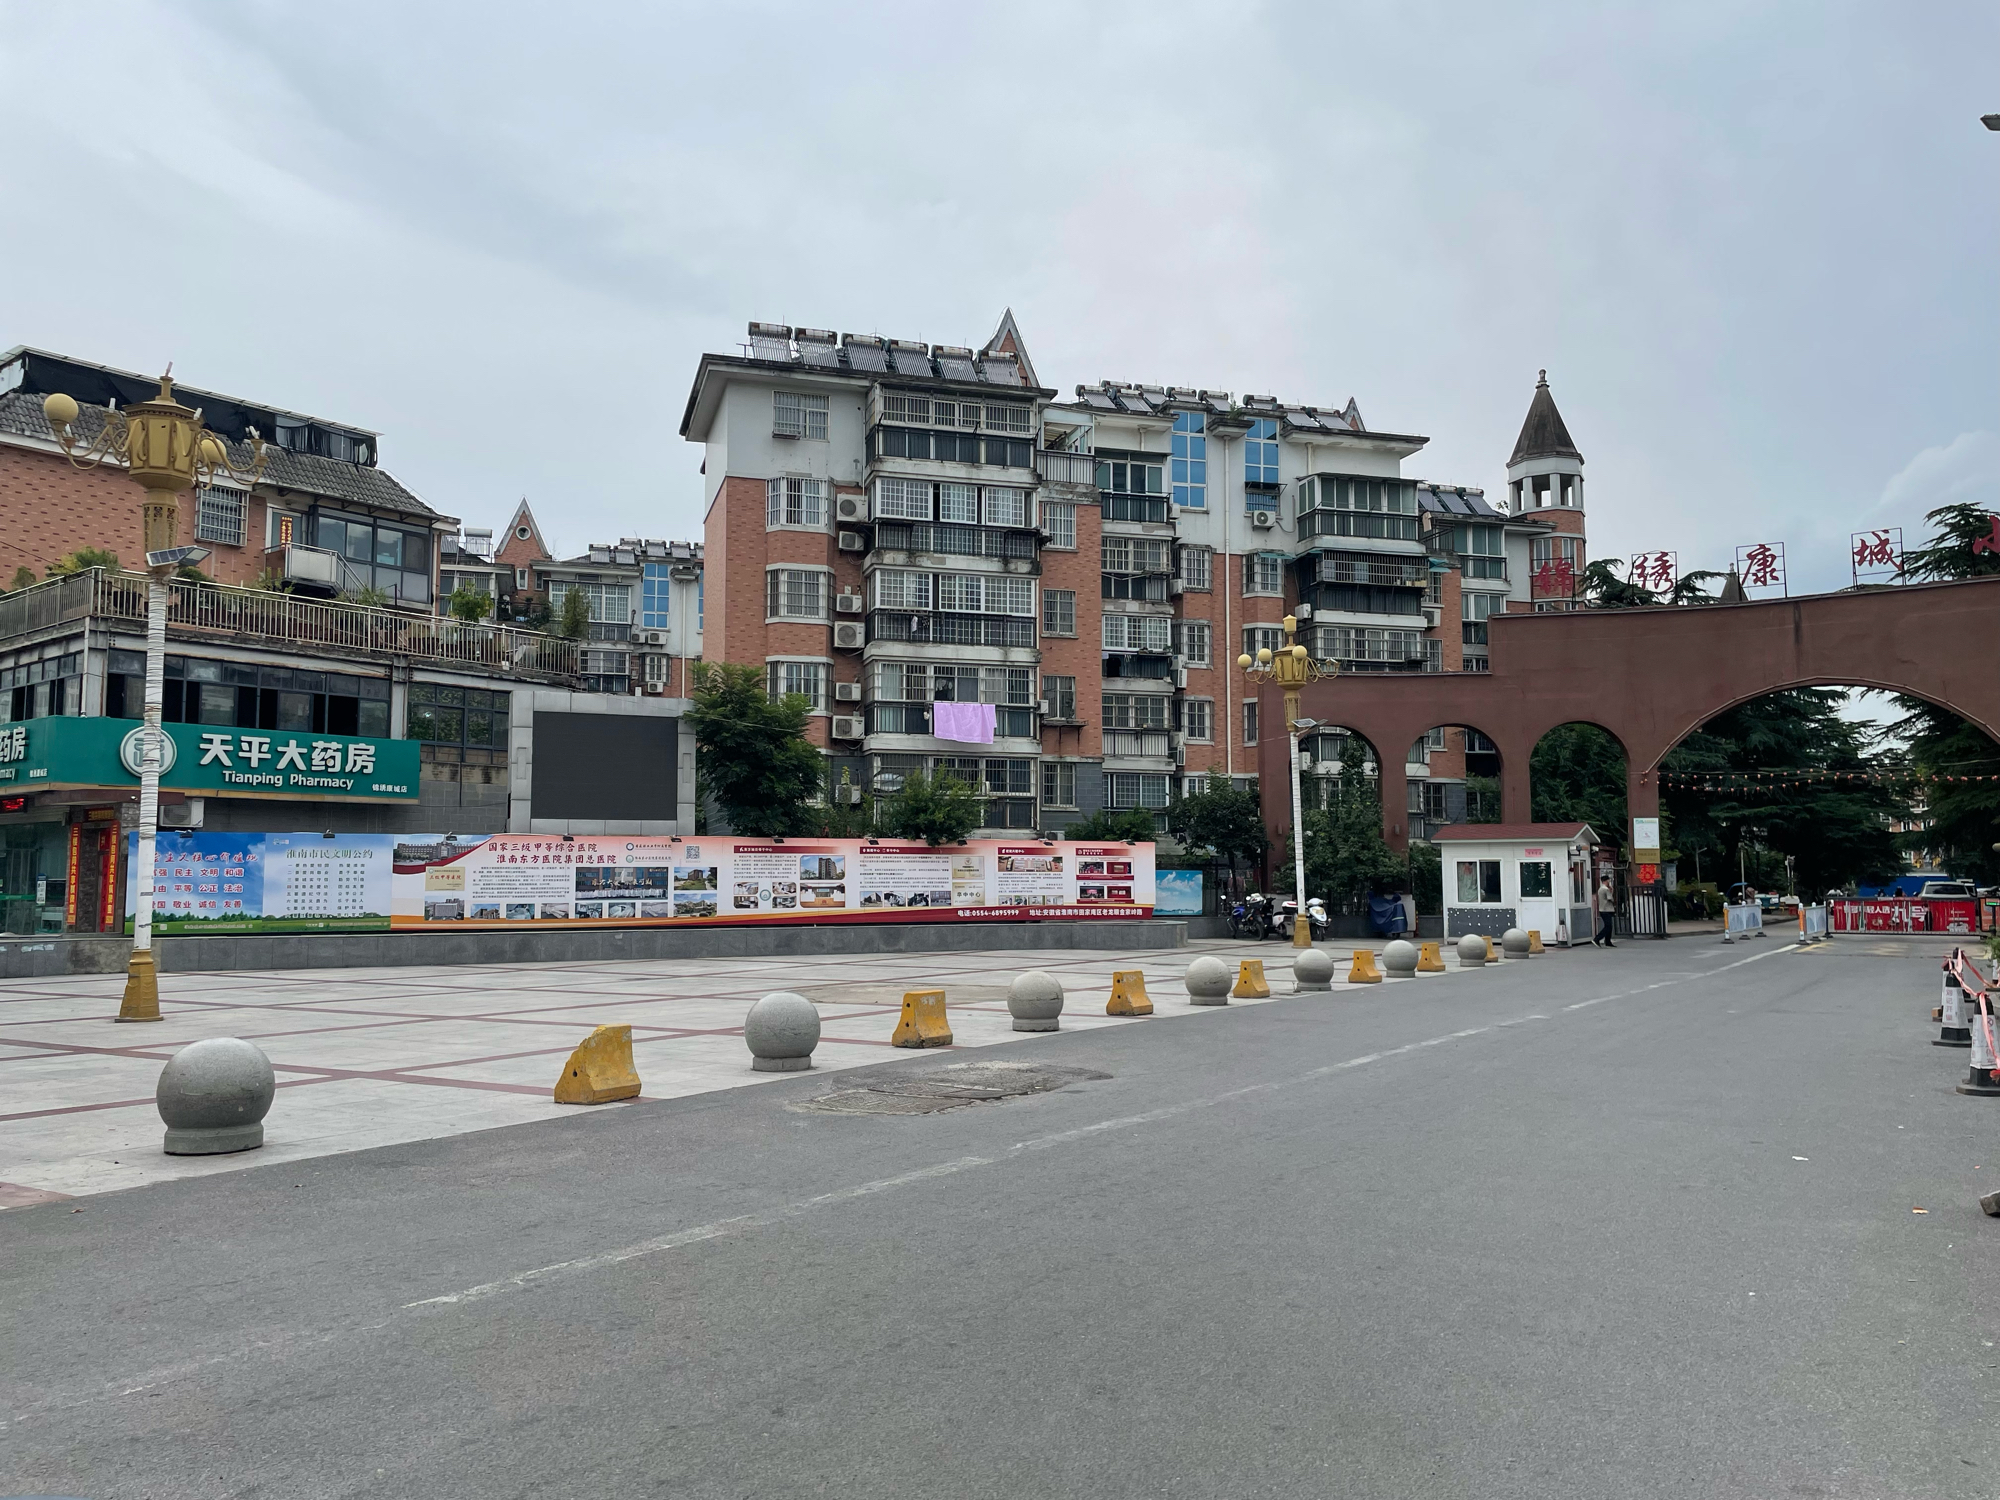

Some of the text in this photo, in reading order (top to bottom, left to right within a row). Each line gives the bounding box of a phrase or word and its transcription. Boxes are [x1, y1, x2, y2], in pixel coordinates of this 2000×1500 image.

[199, 733, 376, 774] 天平大药房
[222, 770, 354, 790] Tianping Pharmacy
[372, 783, 408, 793] 锦绣康城店
[488, 842, 598, 852] 国家三级甲等综合医院
[286, 849, 373, 859] 淮南市民文明公约
[496, 854, 617, 864] 淮南东方医院集团总医院
[174, 868, 193, 877] 民主
[200, 868, 219, 877] 文明
[224, 868, 244, 877] 和谐
[174, 884, 193, 893] 平等
[199, 884, 218, 893] 公正
[224, 884, 243, 893] 法治
[173, 900, 192, 909] 敬业
[199, 900, 217, 909] 诚信
[223, 900, 242, 909] 友善
